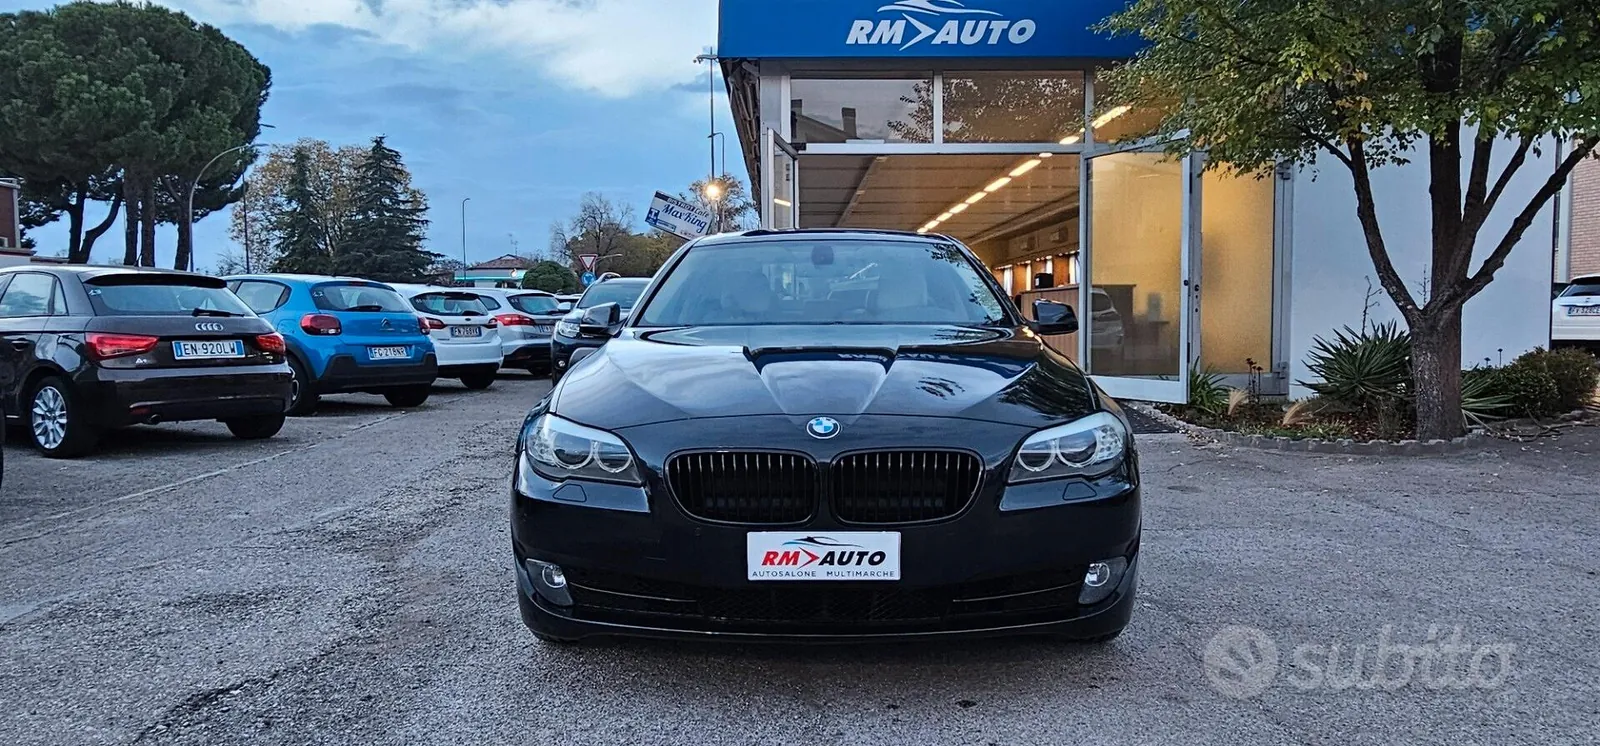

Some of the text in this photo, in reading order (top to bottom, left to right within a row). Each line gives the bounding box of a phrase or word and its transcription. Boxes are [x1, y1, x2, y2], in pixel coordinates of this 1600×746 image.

[845, 18, 1037, 45] RM AUTO
[183, 342, 236, 355] EN 920LW
[761, 550, 887, 566] RM AUTO
[751, 570, 895, 578] AUTOSALONE MULTIMARCHE
